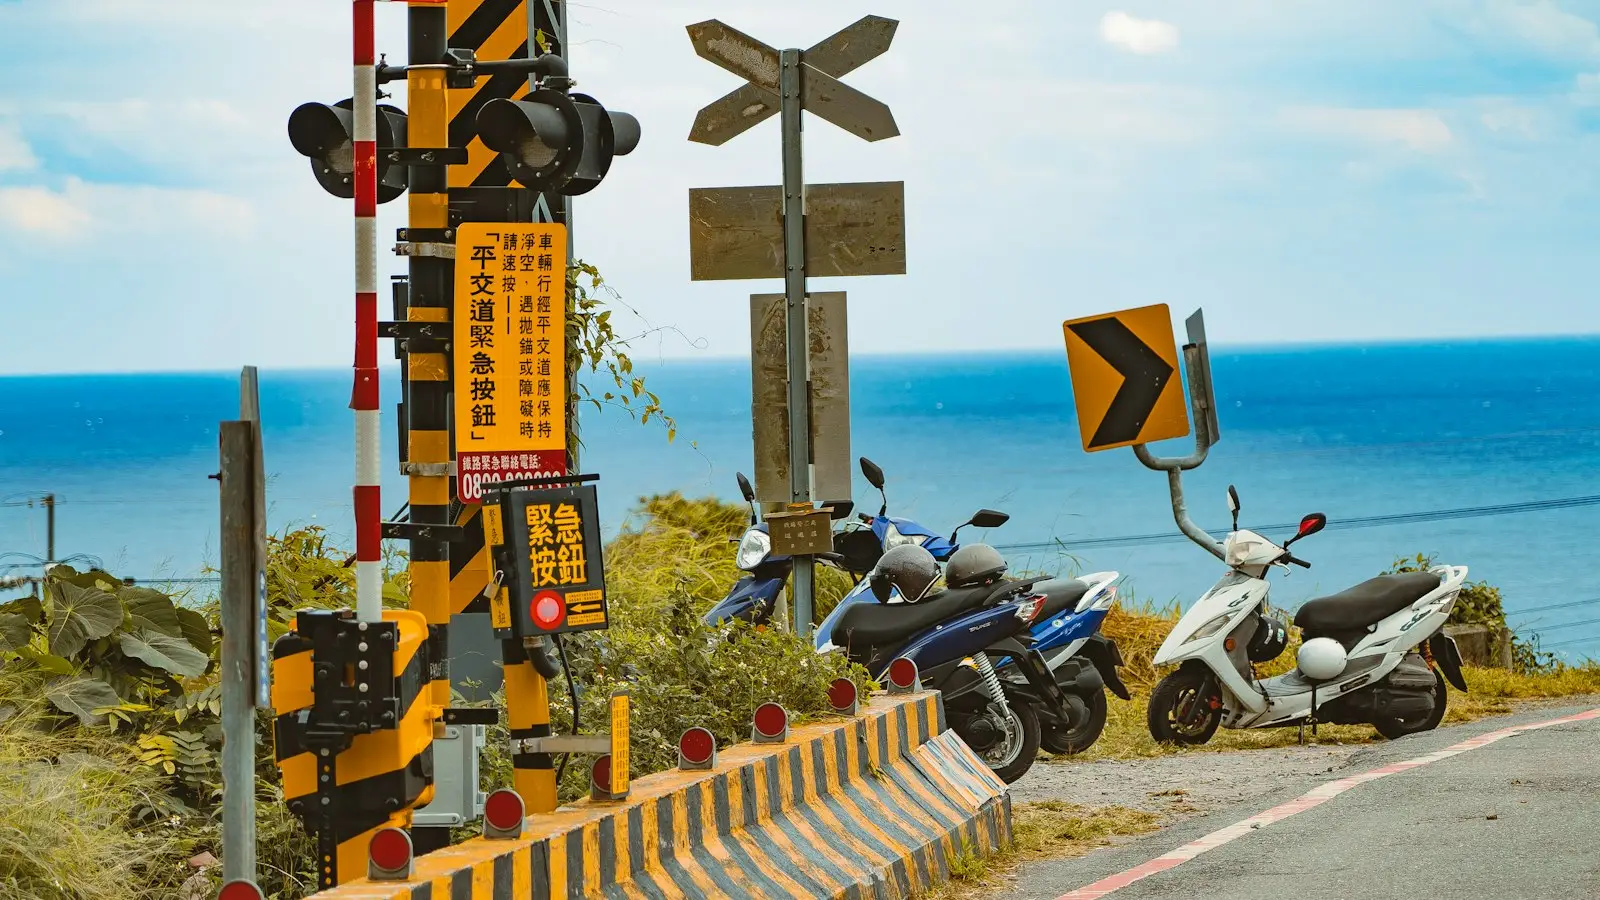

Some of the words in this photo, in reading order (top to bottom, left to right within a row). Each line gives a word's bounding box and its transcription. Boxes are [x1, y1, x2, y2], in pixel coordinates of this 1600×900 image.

[537, 233, 552, 438] 車輛行經平交道應保持
[526, 503, 583, 546] 緊急
[529, 544, 587, 587] 按鈕
